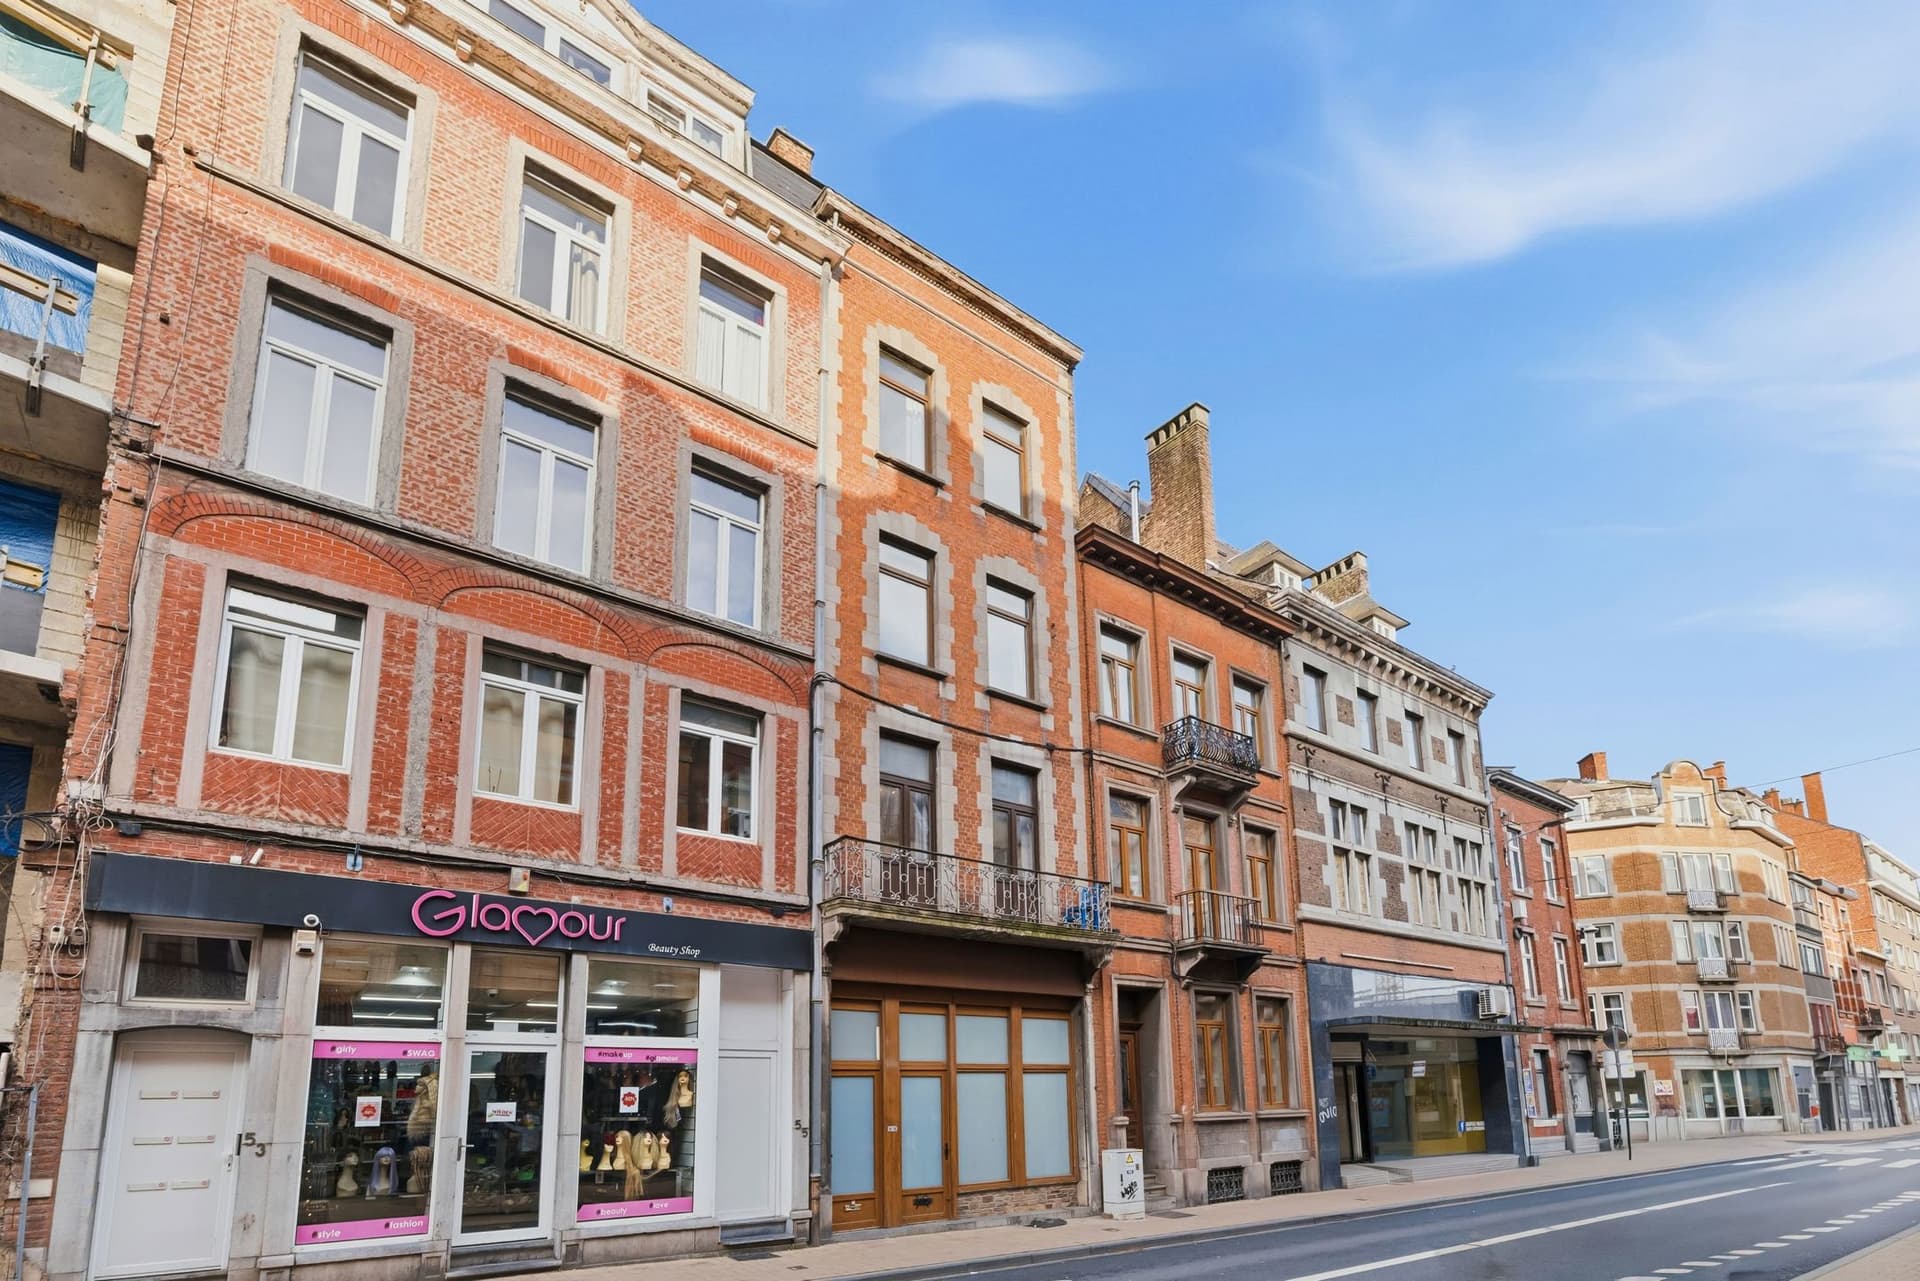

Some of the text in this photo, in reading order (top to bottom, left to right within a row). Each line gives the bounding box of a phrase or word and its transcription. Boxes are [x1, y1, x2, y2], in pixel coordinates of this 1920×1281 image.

[648, 943, 700, 957] Beauty Shop
[794, 1119, 809, 1138] 55
[244, 1132, 266, 1157] 53
